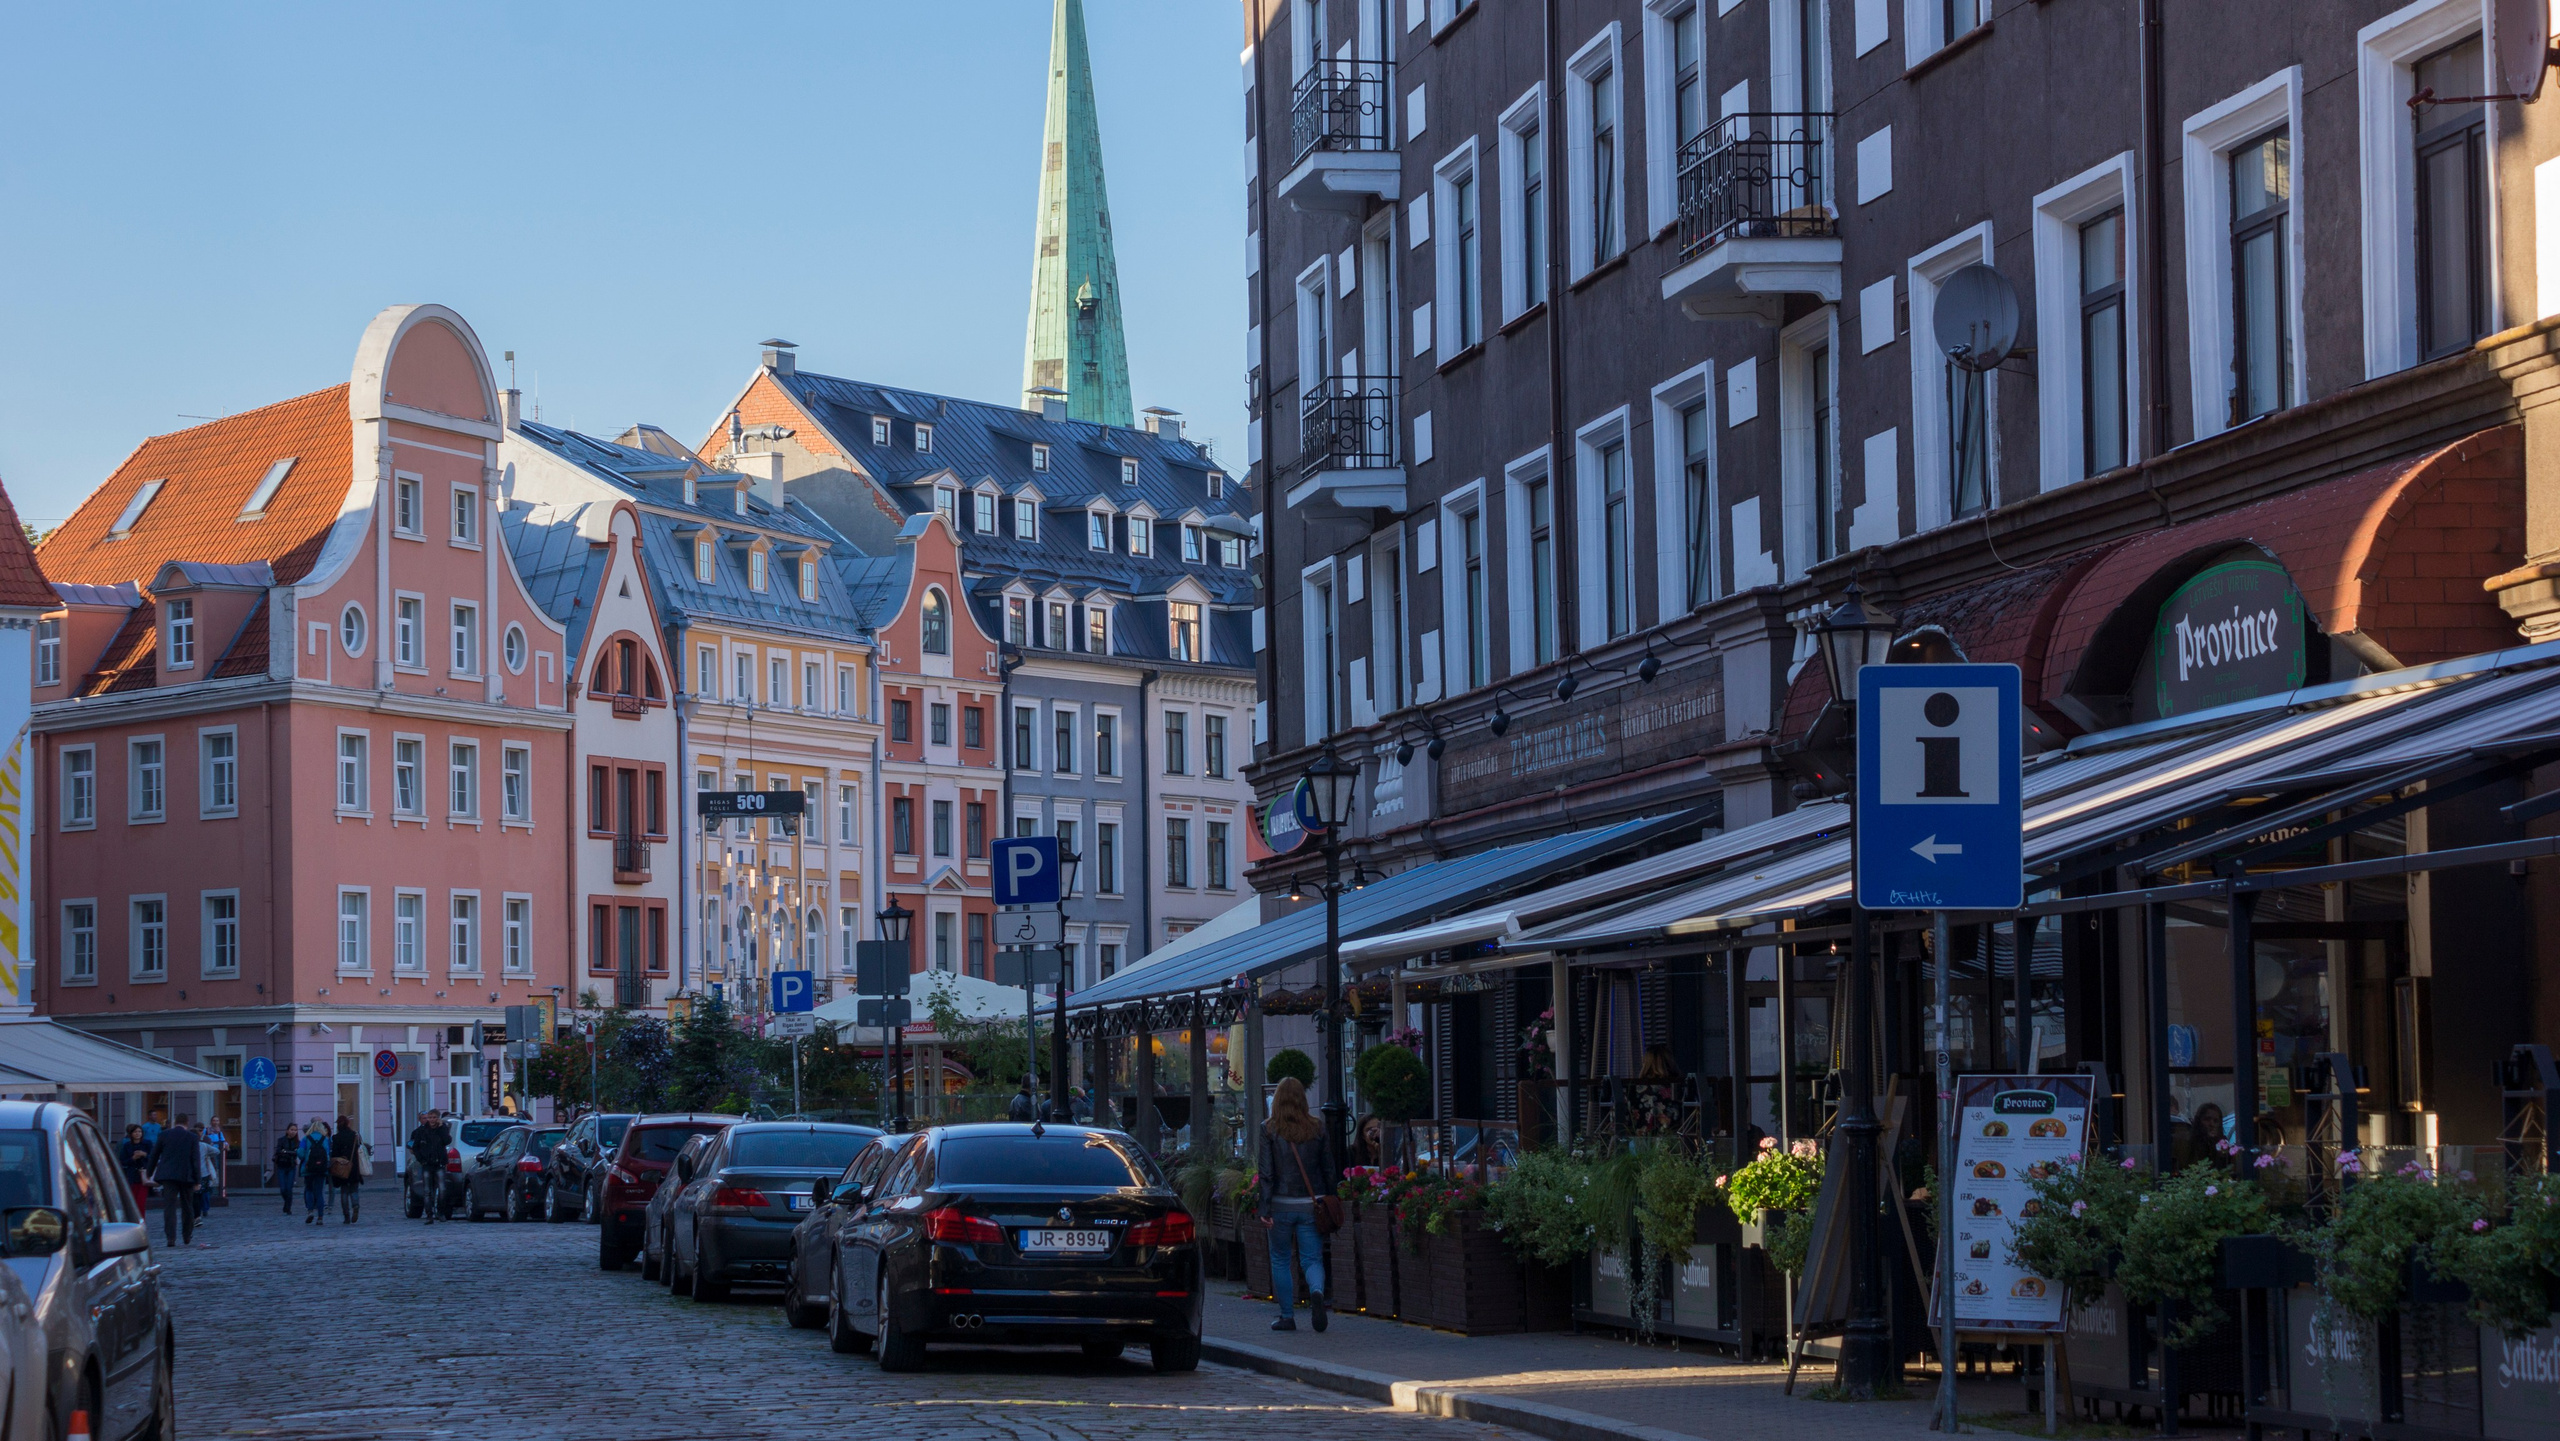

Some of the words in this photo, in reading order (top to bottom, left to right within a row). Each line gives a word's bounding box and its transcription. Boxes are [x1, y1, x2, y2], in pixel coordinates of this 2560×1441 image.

[2189, 576, 2223, 609] LATVIEŠU
[2227, 574, 2259, 592] VIRTUVE
[2175, 604, 2279, 682] Province
[1575, 712, 1607, 762] DĒLS
[736, 794, 766, 810] 500
[1008, 845, 1043, 897] P
[781, 976, 804, 1008] P
[2002, 1097, 2047, 1110] Province
[1032, 1231, 1107, 1247] JR-8994
